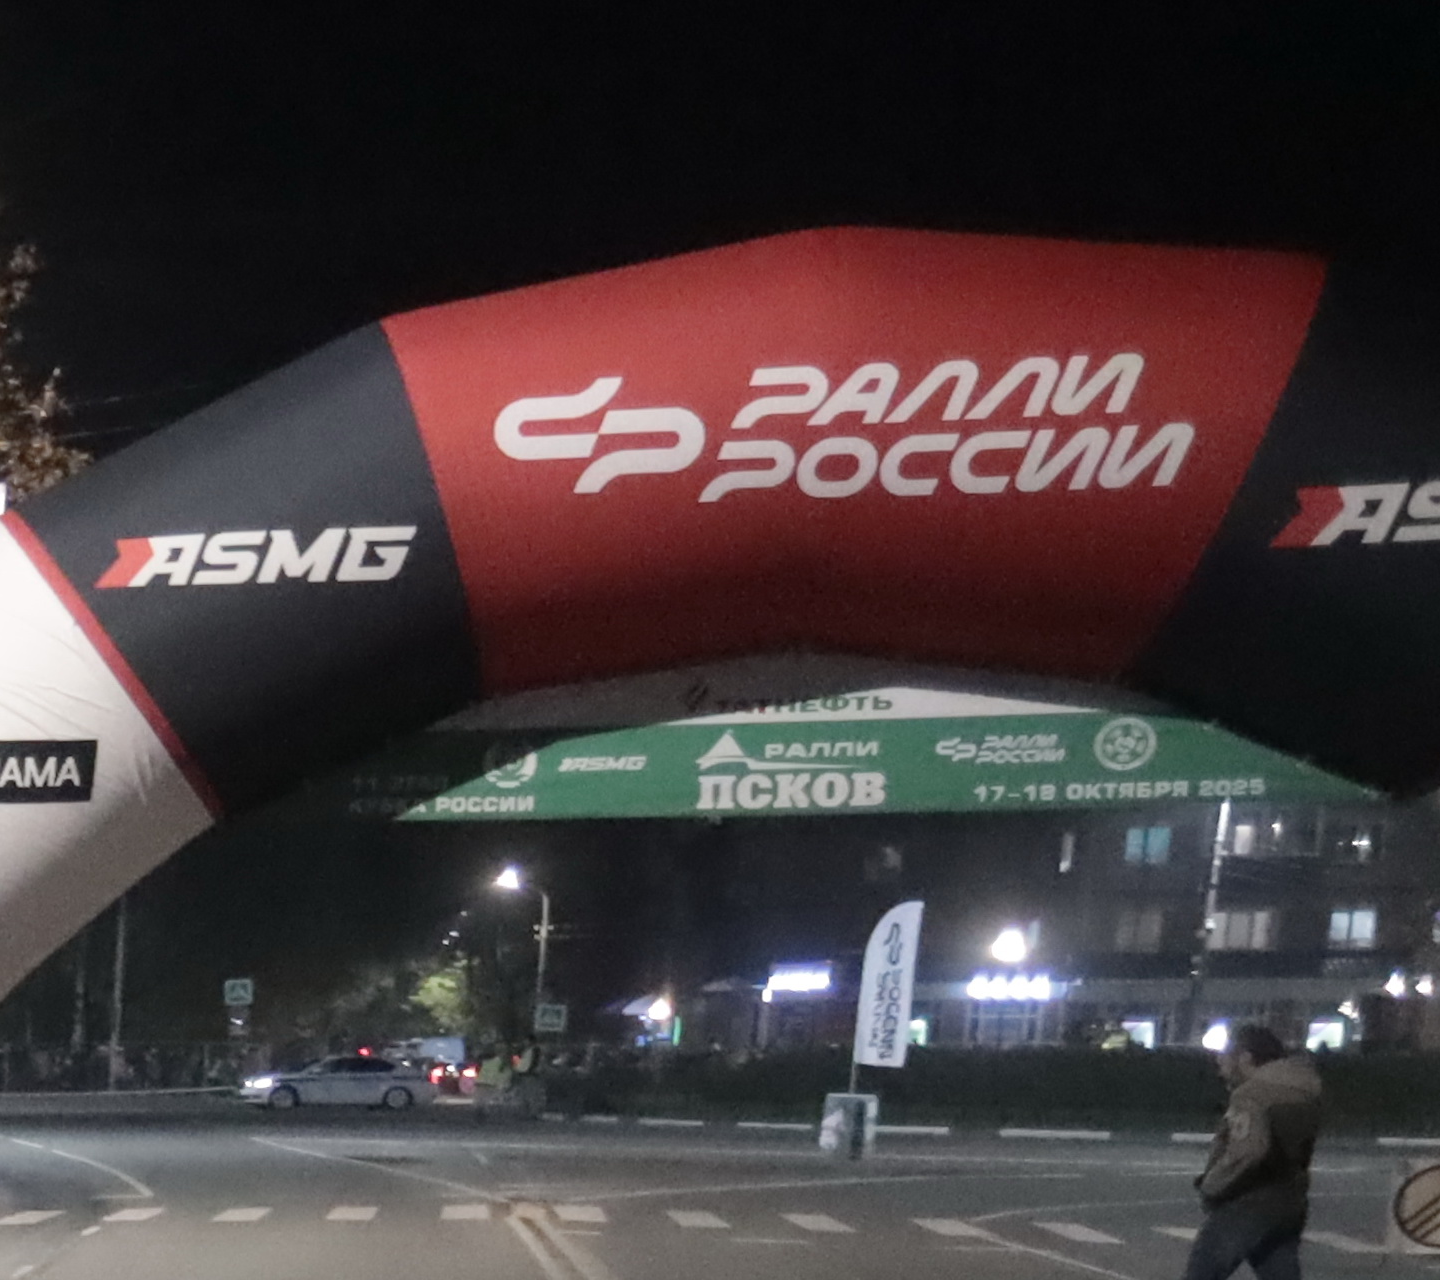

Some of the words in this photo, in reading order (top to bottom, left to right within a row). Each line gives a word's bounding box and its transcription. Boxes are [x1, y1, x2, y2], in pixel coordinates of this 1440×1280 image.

[732, 352, 1146, 428] РАЛЛИ
[698, 422, 1196, 504] РОССИИ
[128, 525, 418, 587] ASMG
[764, 740, 879, 759] РАЛЛИ
[435, 796, 535, 813] РОССИИ
[695, 771, 887, 810] ПСКОВ
[1066, 781, 1189, 801] ОКТЯБРЯ
[1198, 778, 1266, 798] 2025
